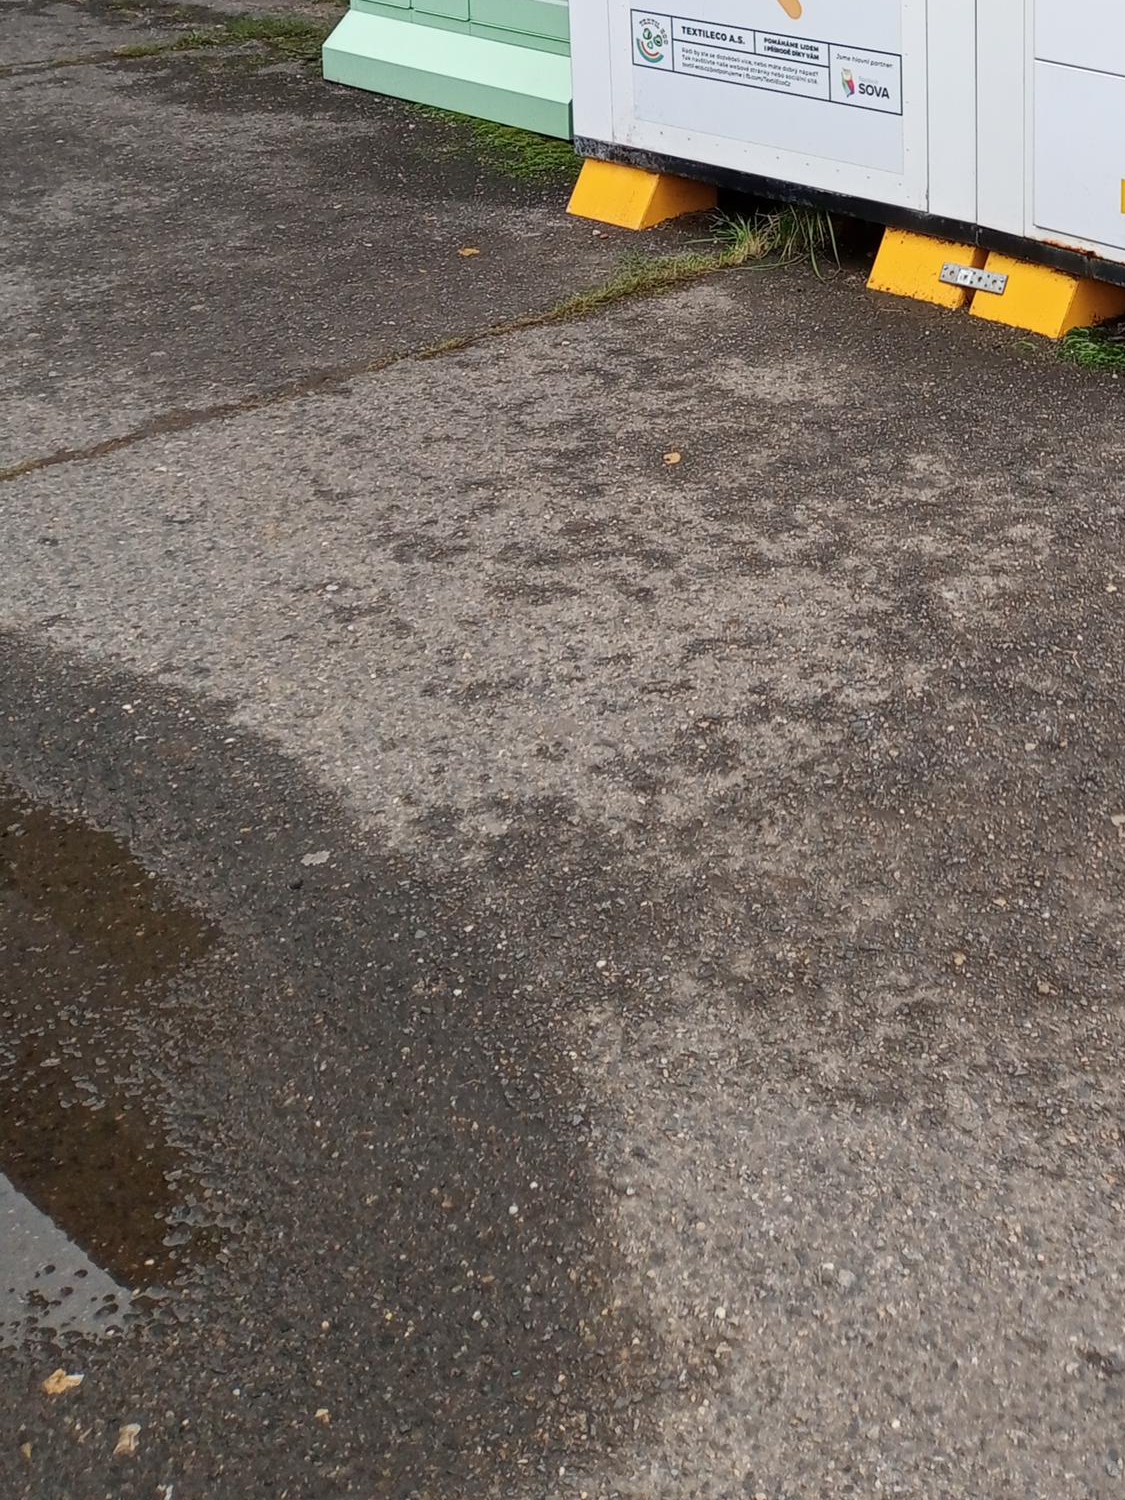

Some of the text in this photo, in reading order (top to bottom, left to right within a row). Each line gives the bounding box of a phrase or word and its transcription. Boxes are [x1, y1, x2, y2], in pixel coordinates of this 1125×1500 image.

[681, 26, 746, 45] TEXTILECO A.S.
[858, 83, 890, 99] SOVA
